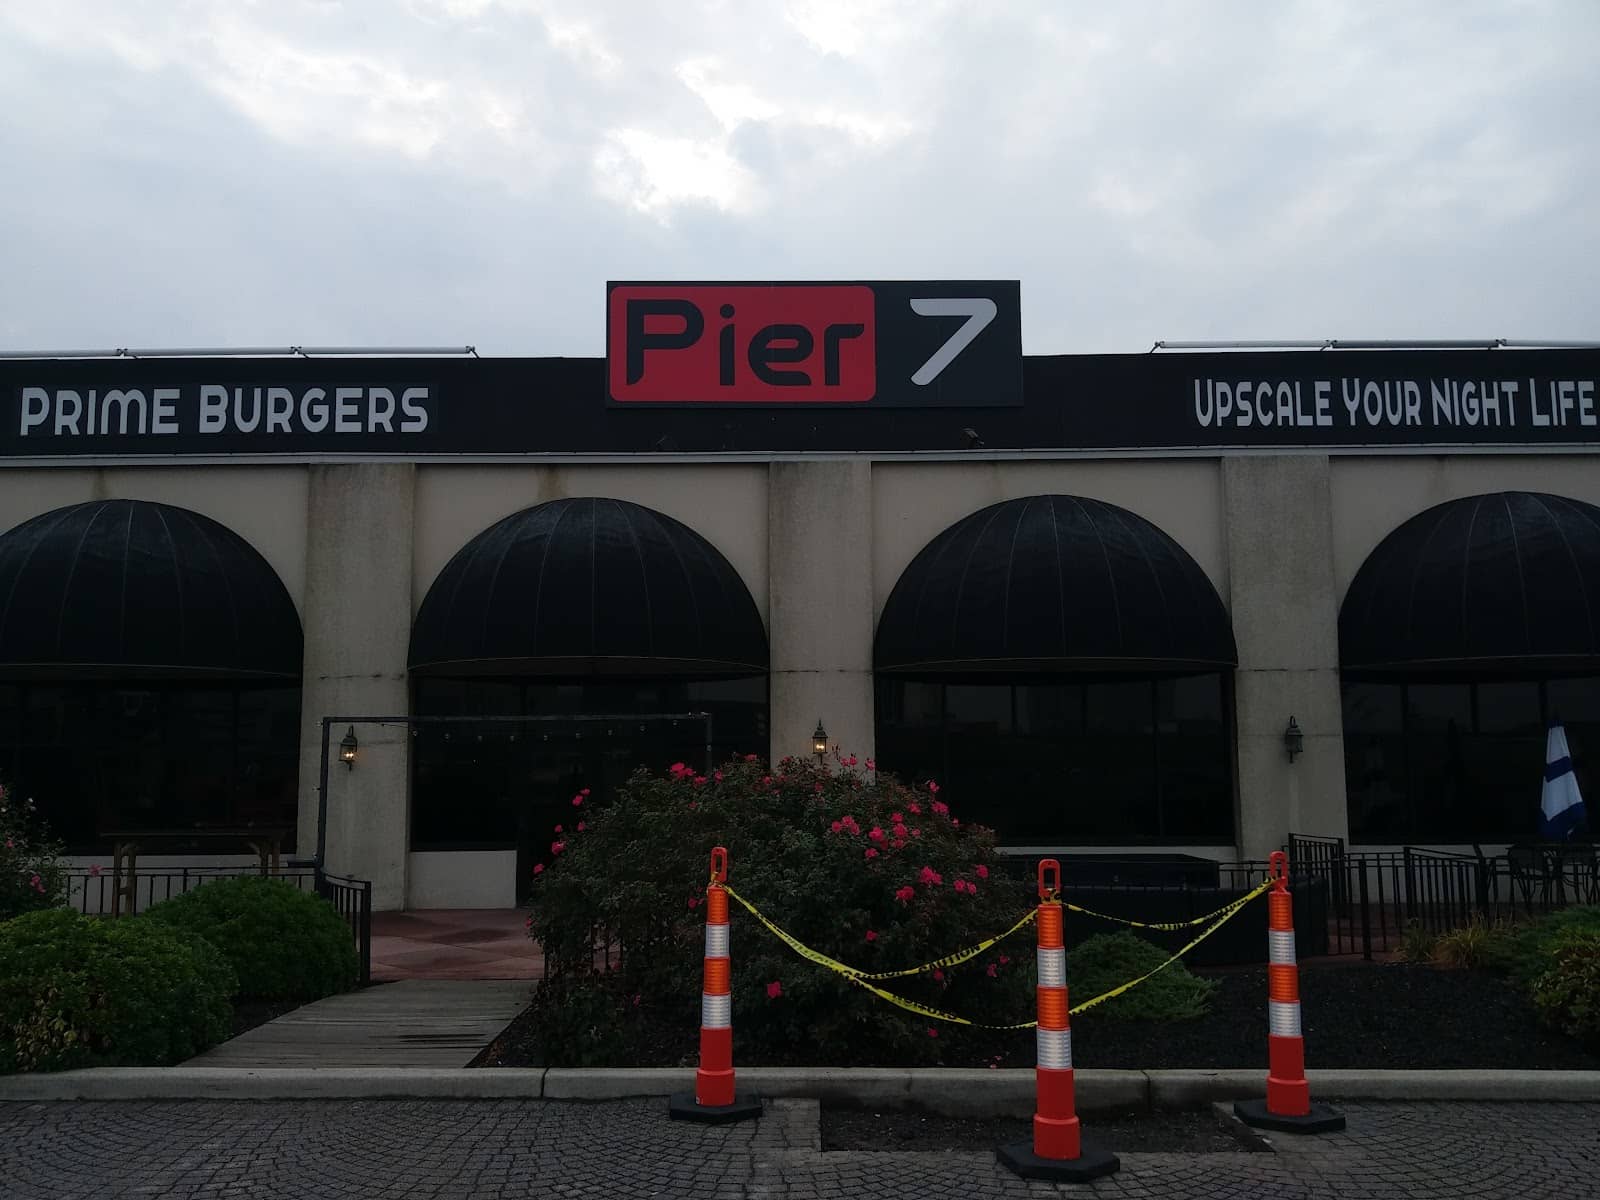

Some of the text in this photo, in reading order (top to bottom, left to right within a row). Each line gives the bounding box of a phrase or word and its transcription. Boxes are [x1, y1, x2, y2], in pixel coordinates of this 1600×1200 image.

[626, 298, 997, 386] Pier 7
[20, 384, 429, 436] PRIME BURGERS
[1194, 377, 1597, 427] UPSCALE YOUR NIGHT LIFE
